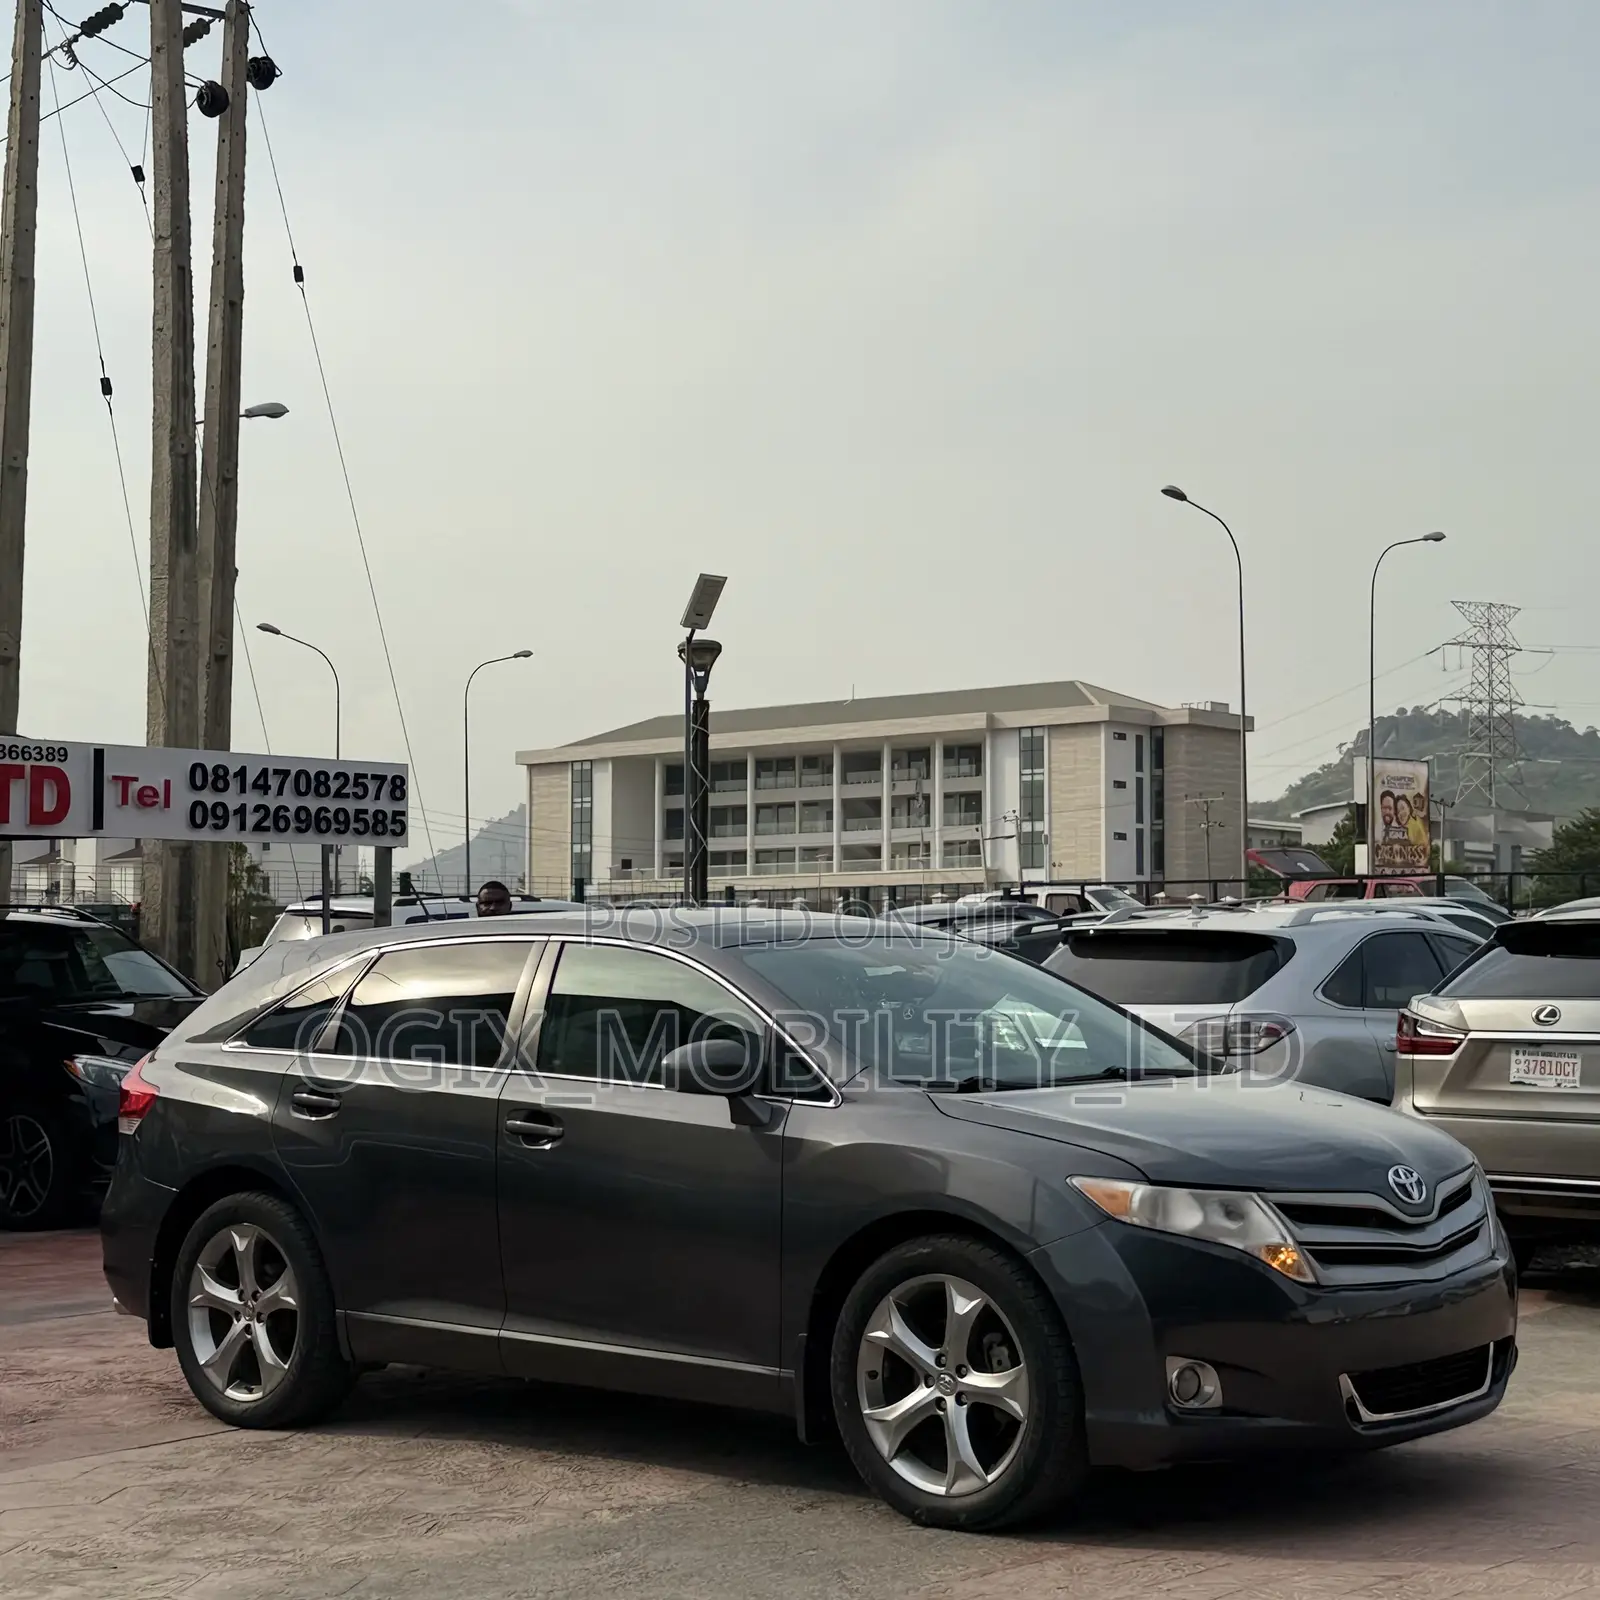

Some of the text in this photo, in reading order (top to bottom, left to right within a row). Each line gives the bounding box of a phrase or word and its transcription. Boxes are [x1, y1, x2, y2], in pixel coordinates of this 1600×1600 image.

[111, 775, 171, 809] Tel
[189, 762, 406, 801] 08147082578
[189, 800, 406, 837] 09126969585
